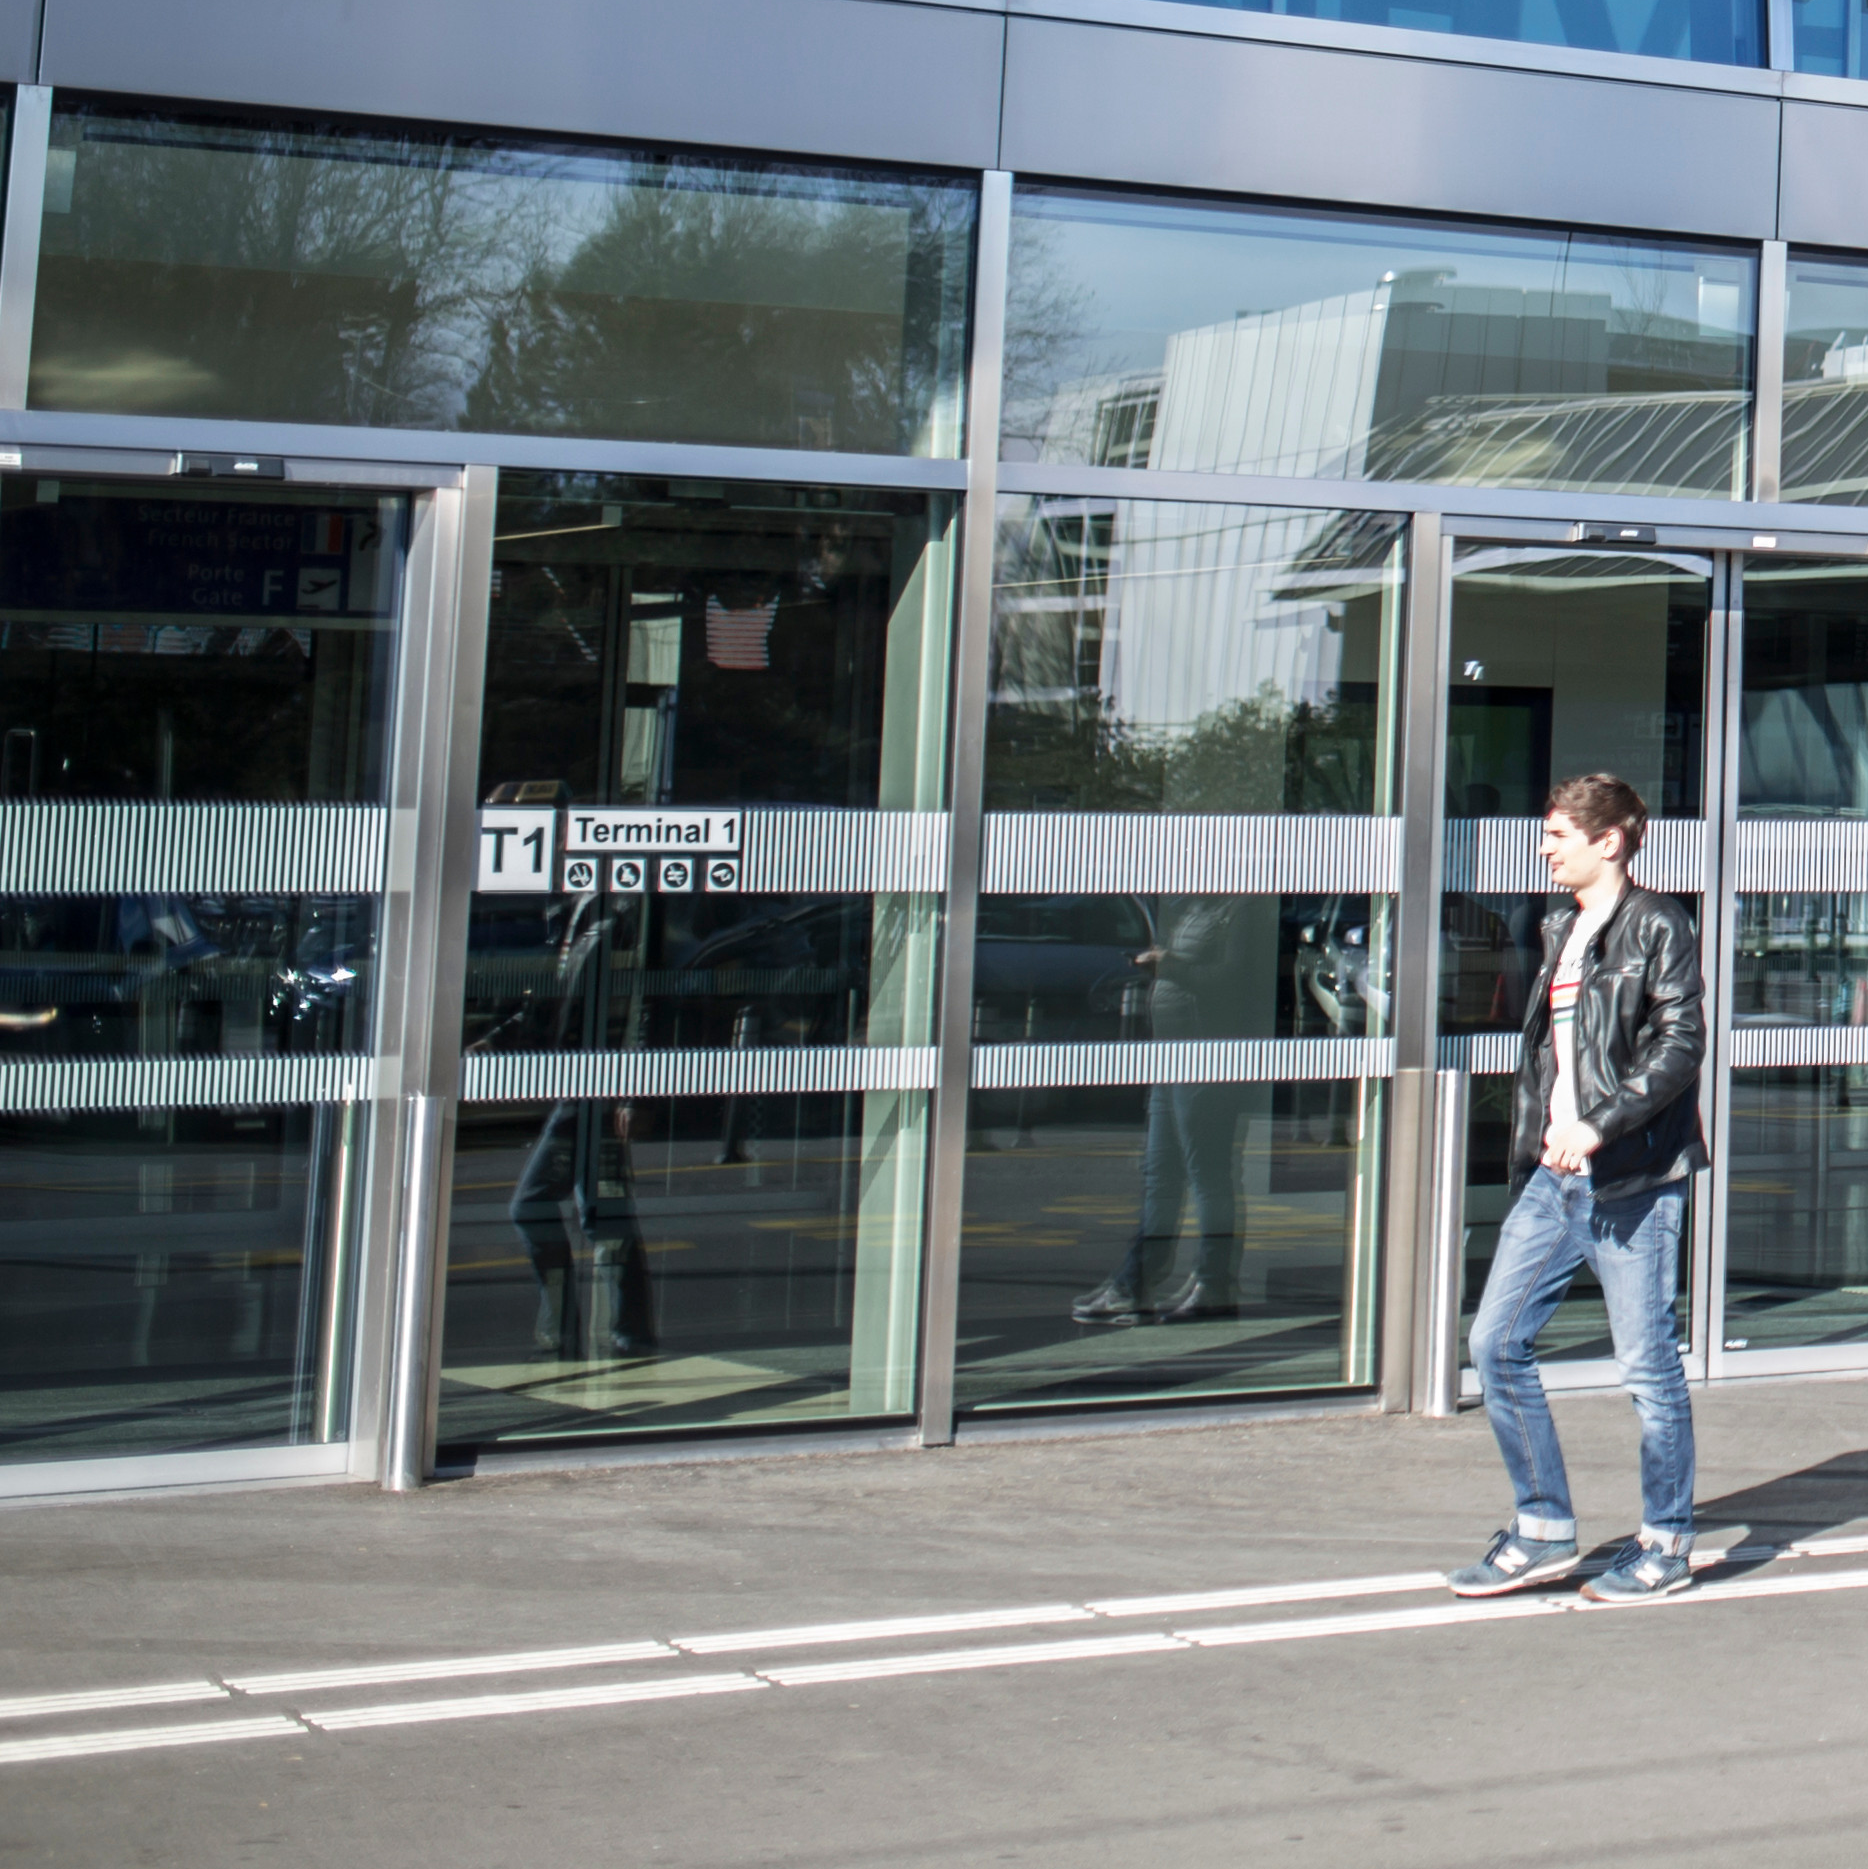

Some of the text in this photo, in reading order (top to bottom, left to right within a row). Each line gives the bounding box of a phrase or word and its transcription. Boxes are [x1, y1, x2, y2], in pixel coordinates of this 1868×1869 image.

[138, 504, 297, 529] Secteur France
[147, 528, 296, 552] French Sector
[186, 563, 246, 583] Porte
[190, 587, 244, 607] Gate
[261, 569, 285, 607] F
[574, 817, 736, 844] Terminal 1
[481, 826, 544, 874] T1
